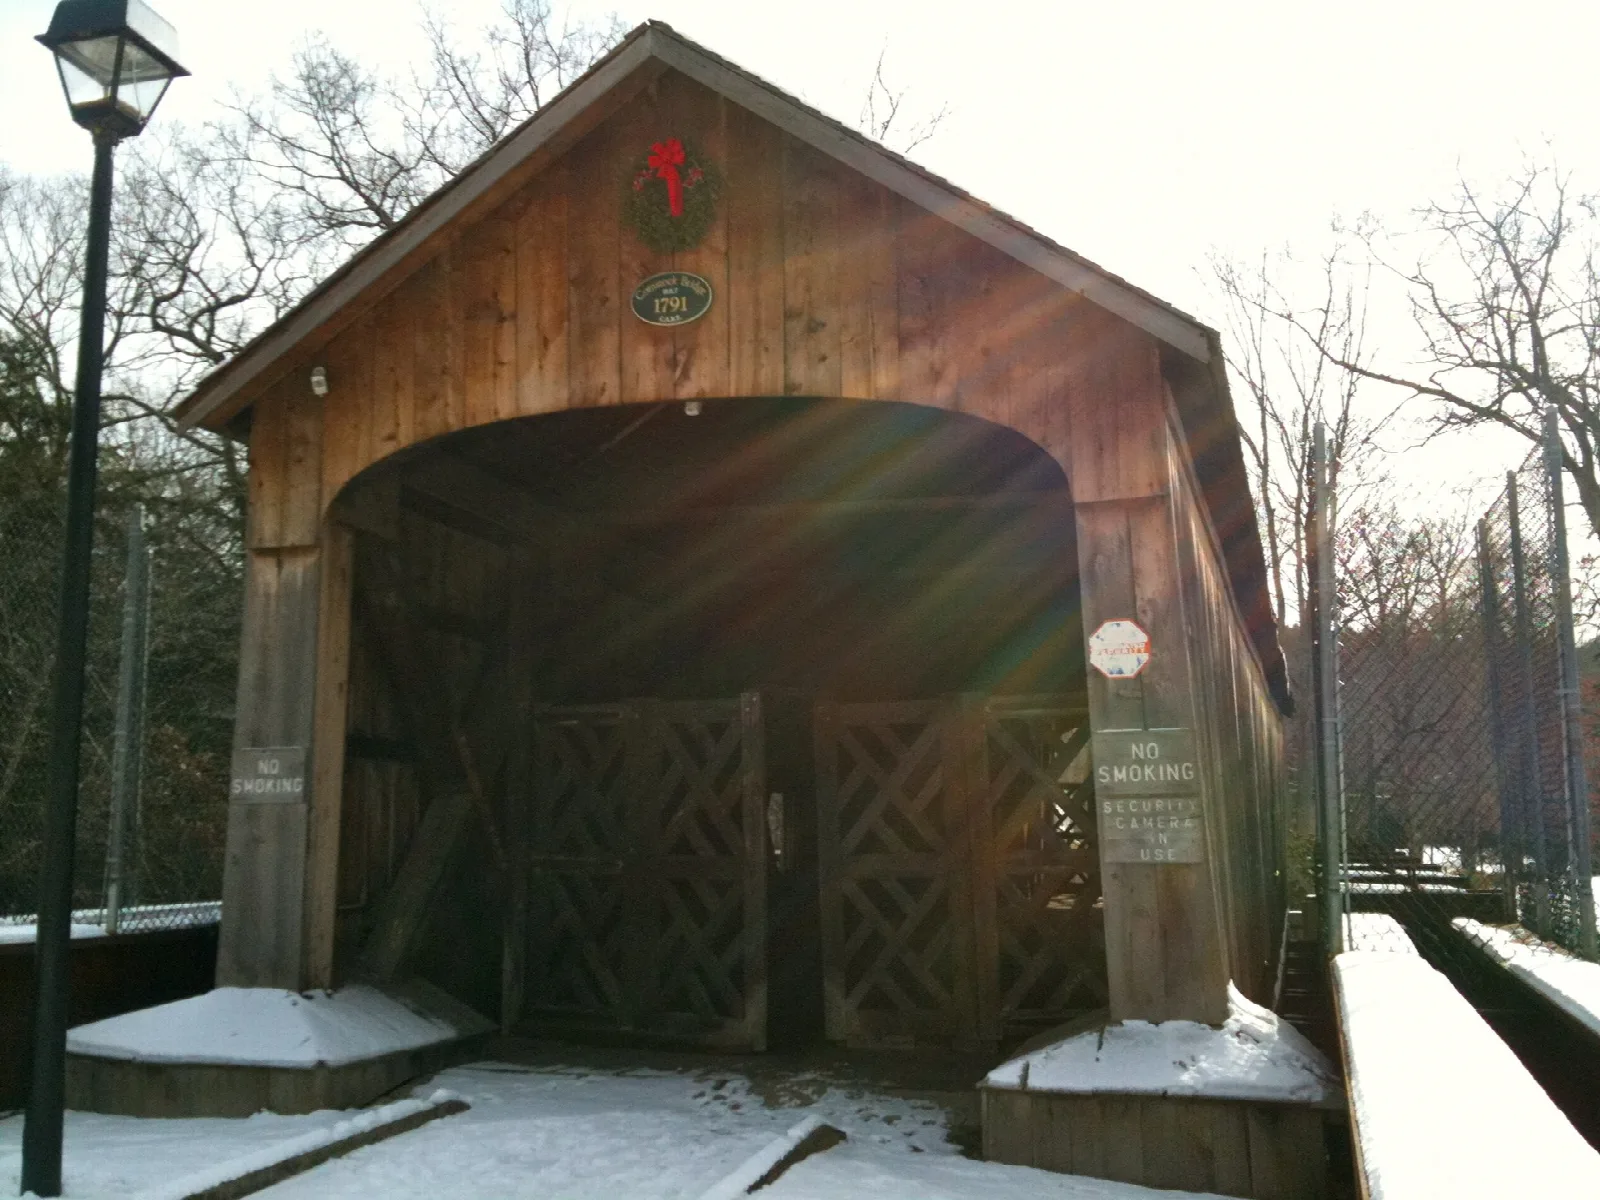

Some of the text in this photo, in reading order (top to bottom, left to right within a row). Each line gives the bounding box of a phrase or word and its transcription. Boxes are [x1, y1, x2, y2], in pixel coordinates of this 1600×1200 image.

[654, 296, 687, 313] 1791
[1131, 742, 1159, 760] NO
[258, 759, 279, 774] NO
[1098, 763, 1194, 782] SMOKING
[230, 777, 303, 794] SMOKING
[1103, 799, 1196, 815] SECURITY
[1140, 848, 1177, 861] USE
